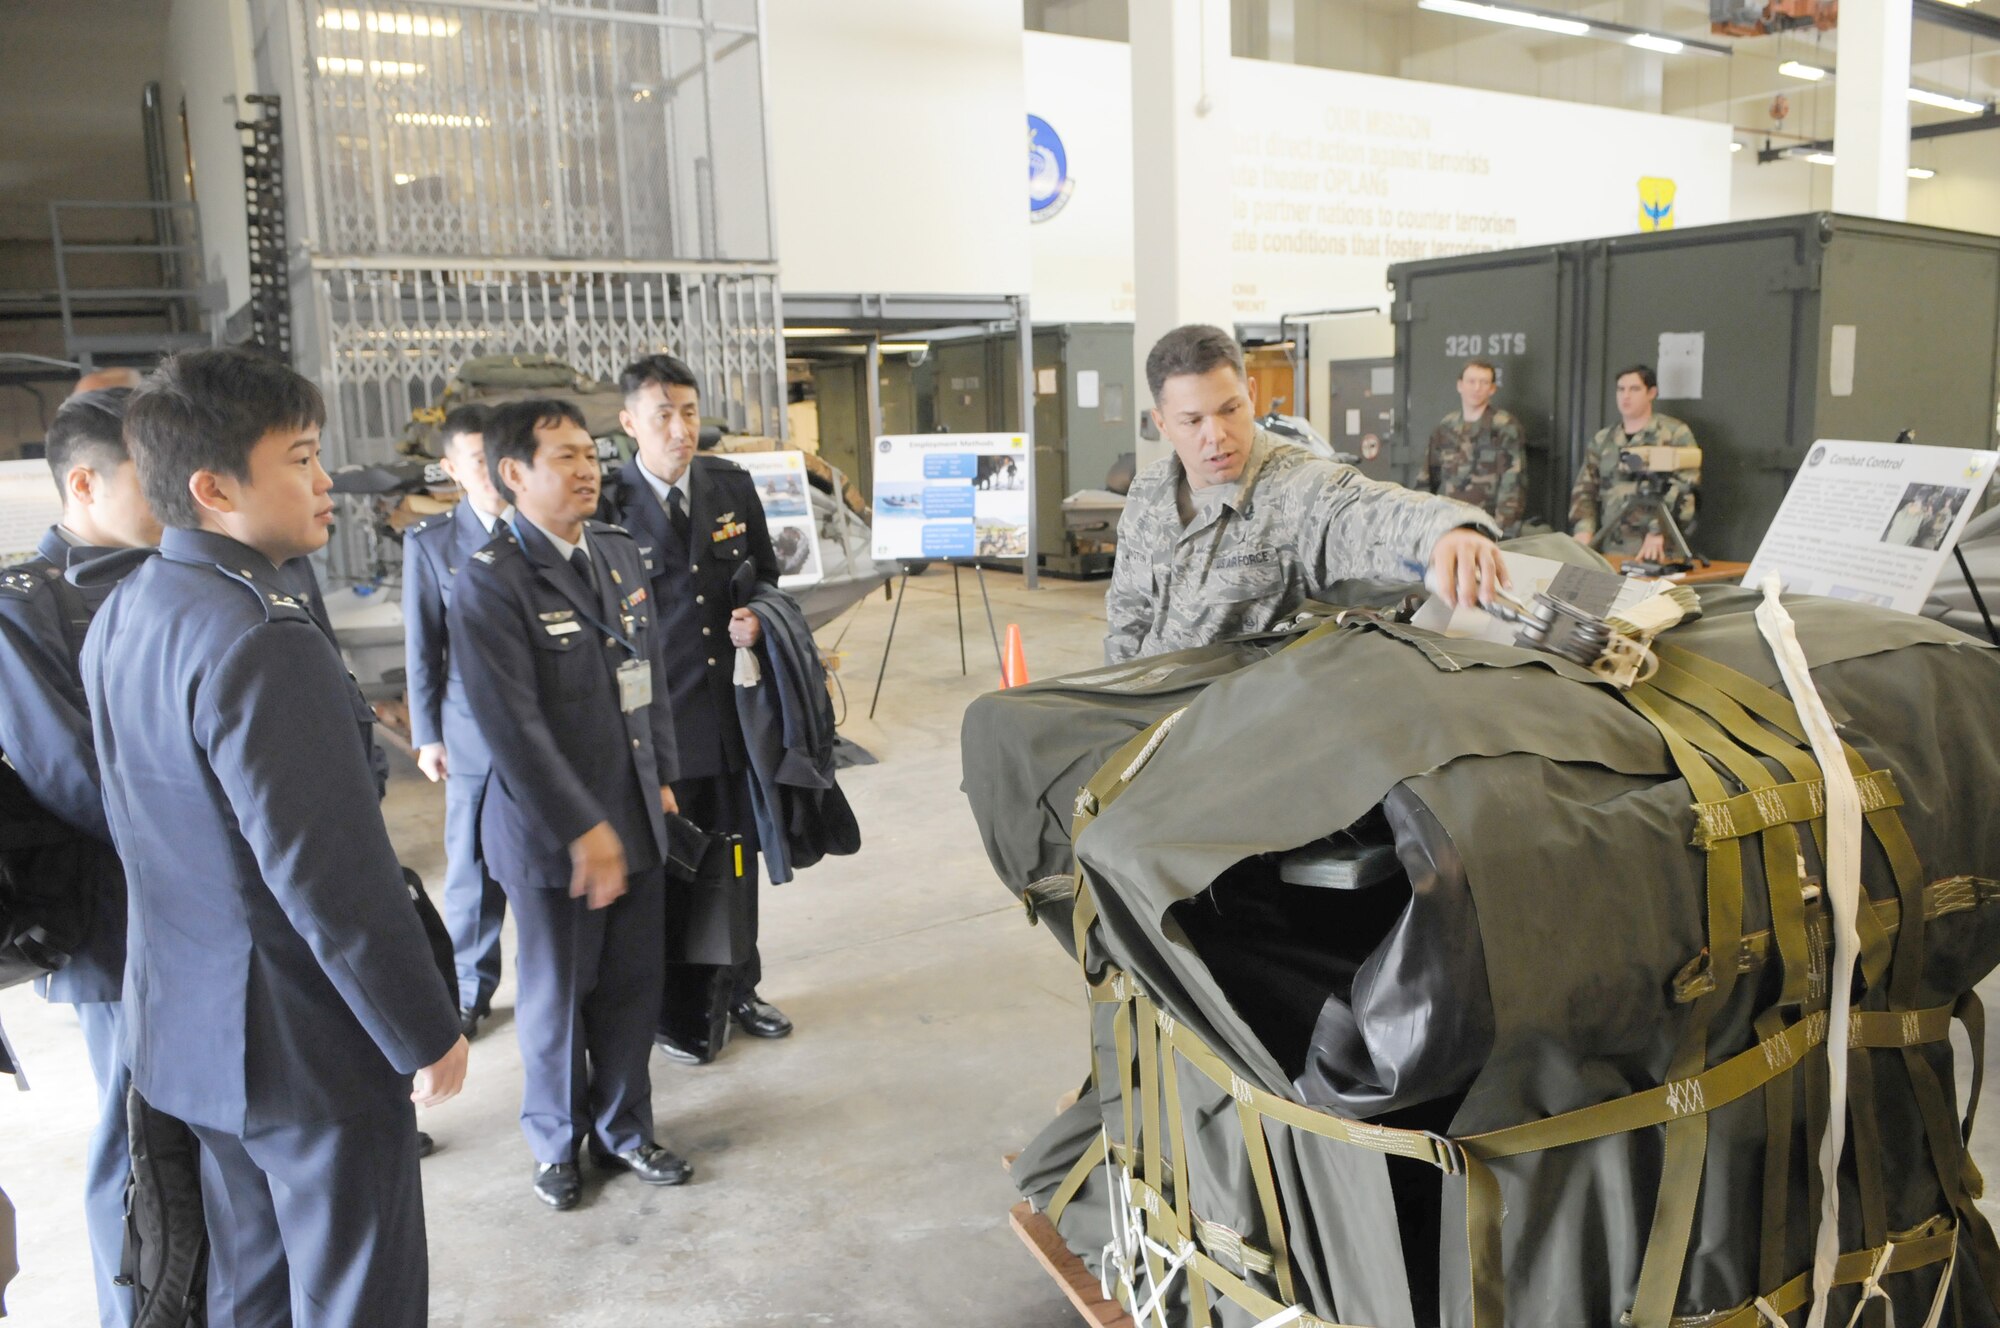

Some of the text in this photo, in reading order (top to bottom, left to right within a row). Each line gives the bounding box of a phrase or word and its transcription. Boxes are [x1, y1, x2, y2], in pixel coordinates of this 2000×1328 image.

[1318, 137, 1364, 163] action
[1369, 143, 1424, 171] against
[1428, 149, 1490, 176] terrorists
[1264, 163, 1318, 192] theater
[1324, 168, 1389, 197] OPLANs
[1254, 198, 1312, 226] partner
[1317, 203, 1374, 226] nations
[1378, 205, 1393, 228] to
[1397, 208, 1452, 232] counter
[1456, 210, 1517, 235] terrorism
[1262, 230, 1347, 256] conditions
[1352, 233, 1380, 257] that
[1385, 234, 1427, 258] foster
[1445, 332, 1527, 357] 320 STS
[909, 440, 994, 449] Employment Methods
[1830, 453, 1904, 470] Combat Control
[1238, 551, 1269, 566] FORCE
